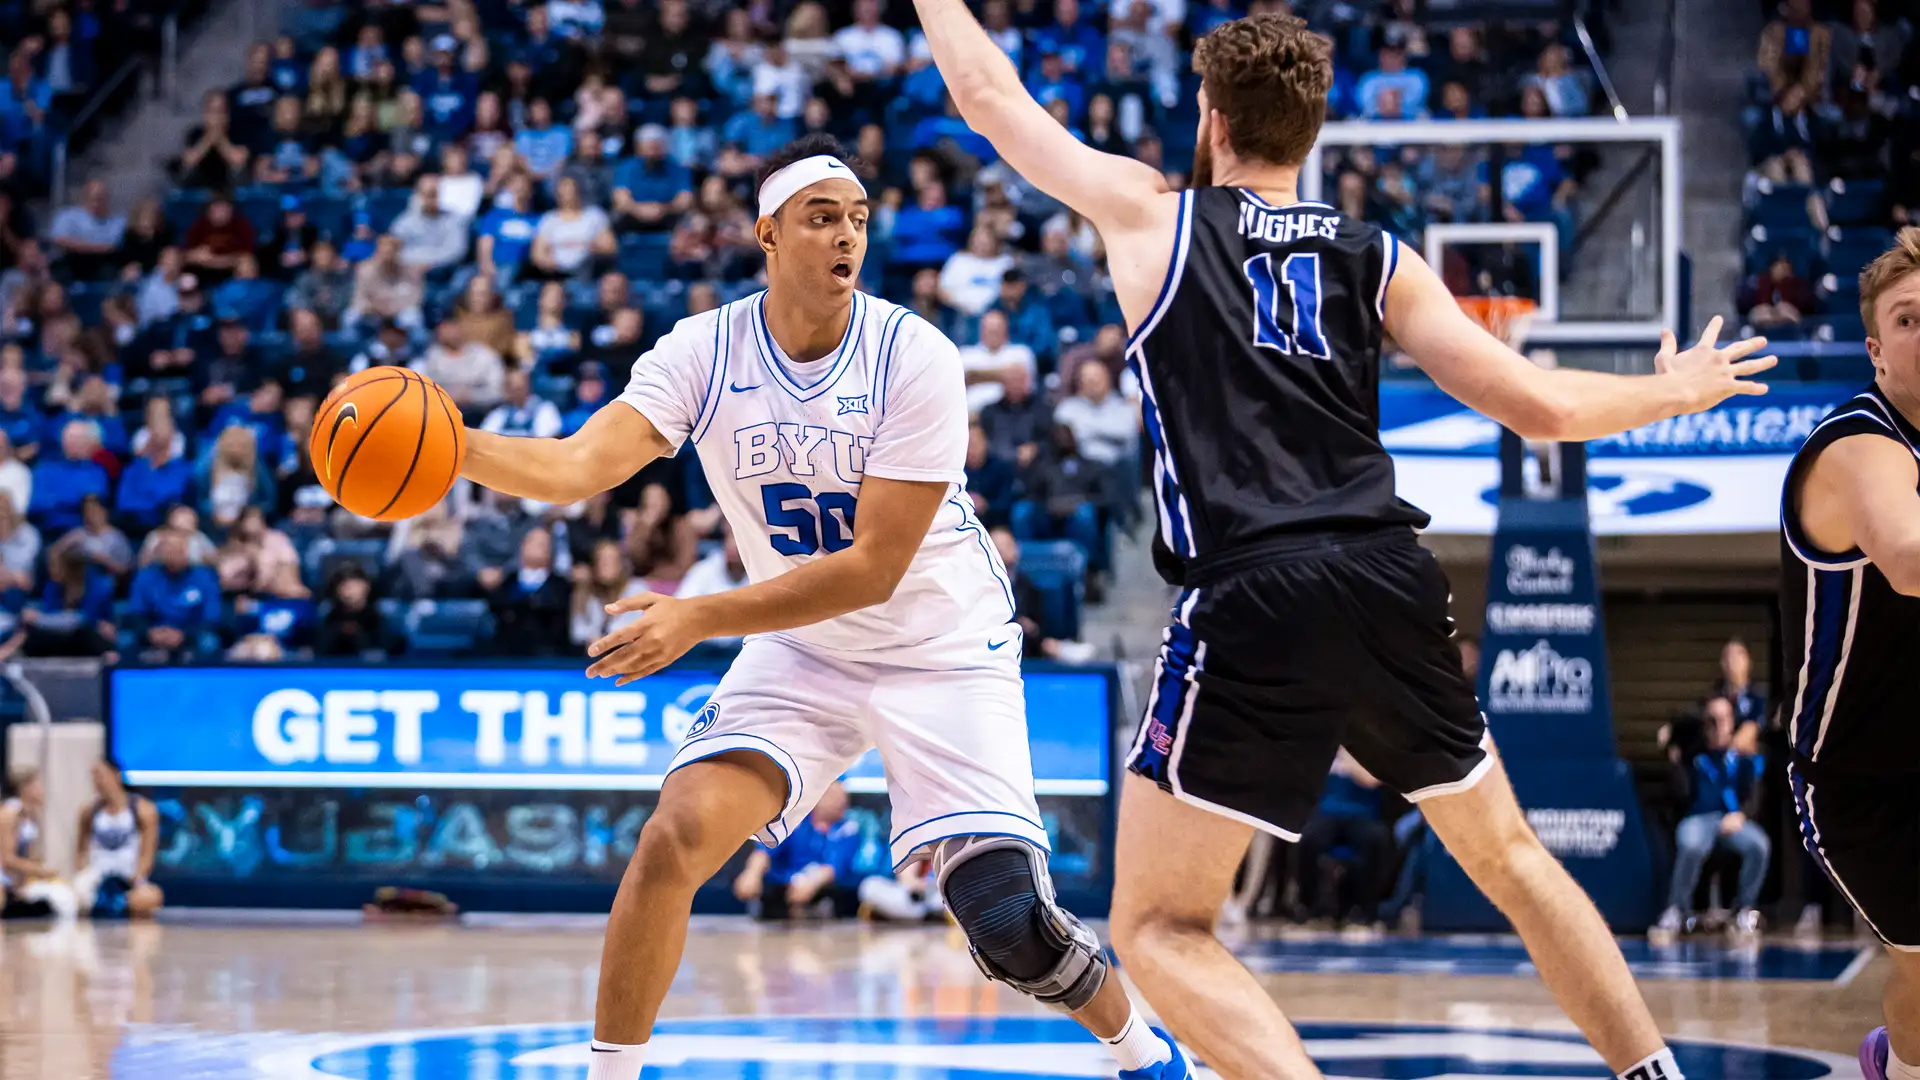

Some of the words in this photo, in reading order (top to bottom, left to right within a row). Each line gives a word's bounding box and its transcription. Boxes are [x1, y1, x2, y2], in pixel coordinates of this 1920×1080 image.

[1242, 252, 1332, 361] 11
[734, 421, 876, 485] BYU
[760, 482, 859, 557] 50
[252, 688, 439, 764] GET
[459, 690, 648, 765] THE
